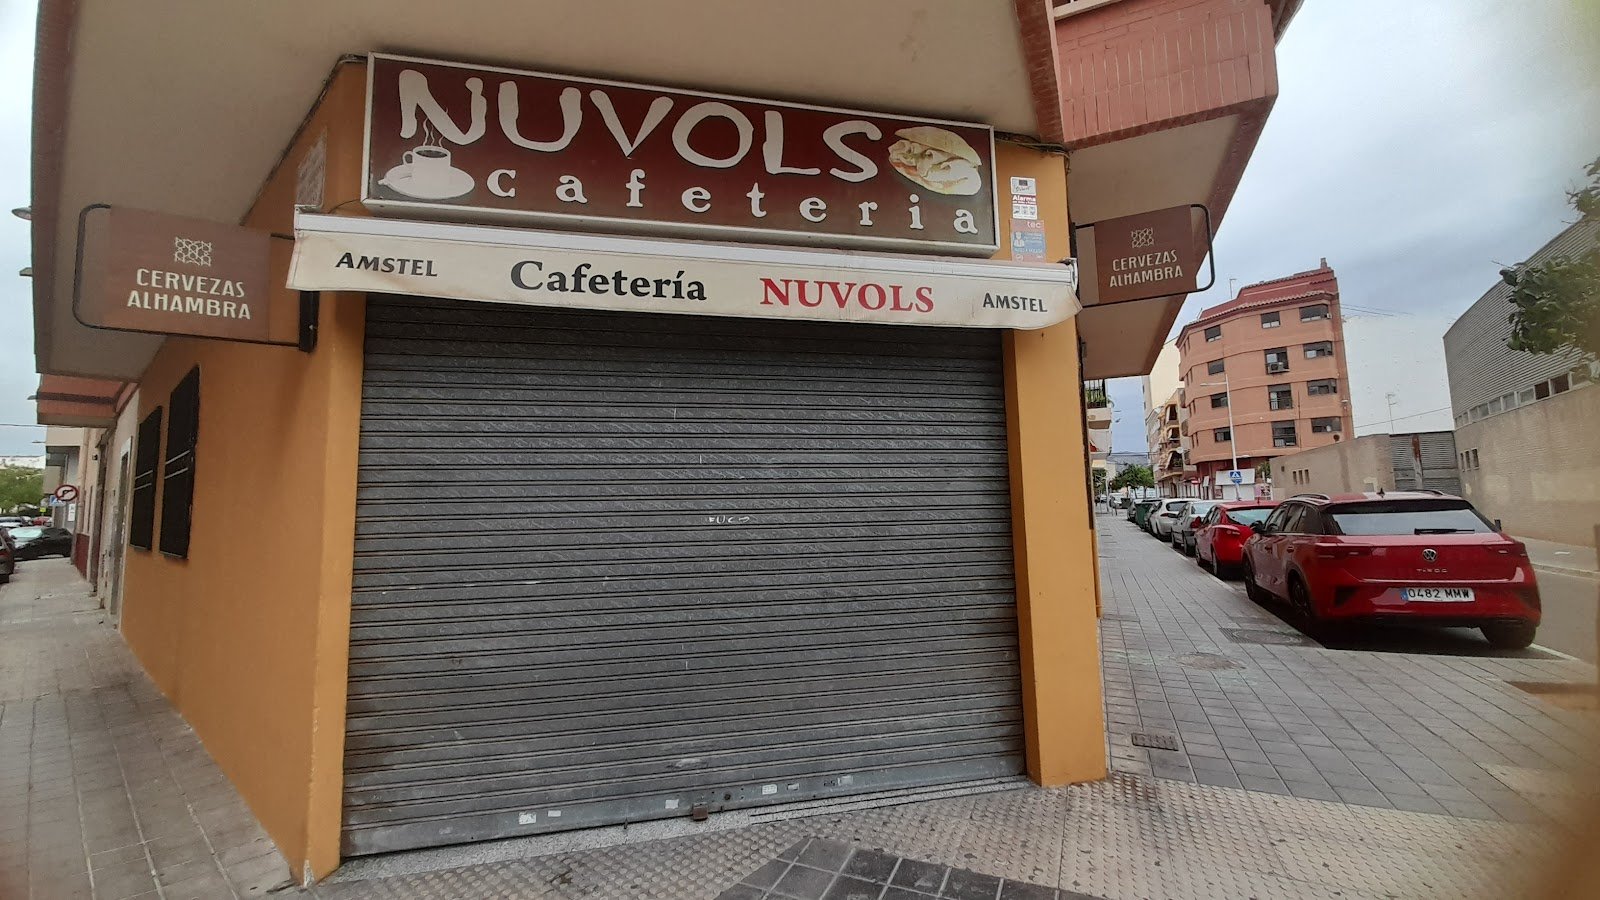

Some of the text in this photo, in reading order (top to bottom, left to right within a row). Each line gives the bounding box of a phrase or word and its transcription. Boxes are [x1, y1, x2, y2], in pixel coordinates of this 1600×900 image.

[399, 69, 883, 183] NUVOLS
[487, 168, 978, 235] cafeteria
[1112, 249, 1178, 272] CERVEZAS
[136, 268, 245, 298] CERVEZAS
[335, 252, 1048, 313] AMSTEL Cafetería NUVOLS AMSTEL
[1109, 265, 1183, 288] ALHAMBRA
[127, 290, 251, 320] ALHAMBRA
[1408, 588, 1469, 598] 0482 MMW
